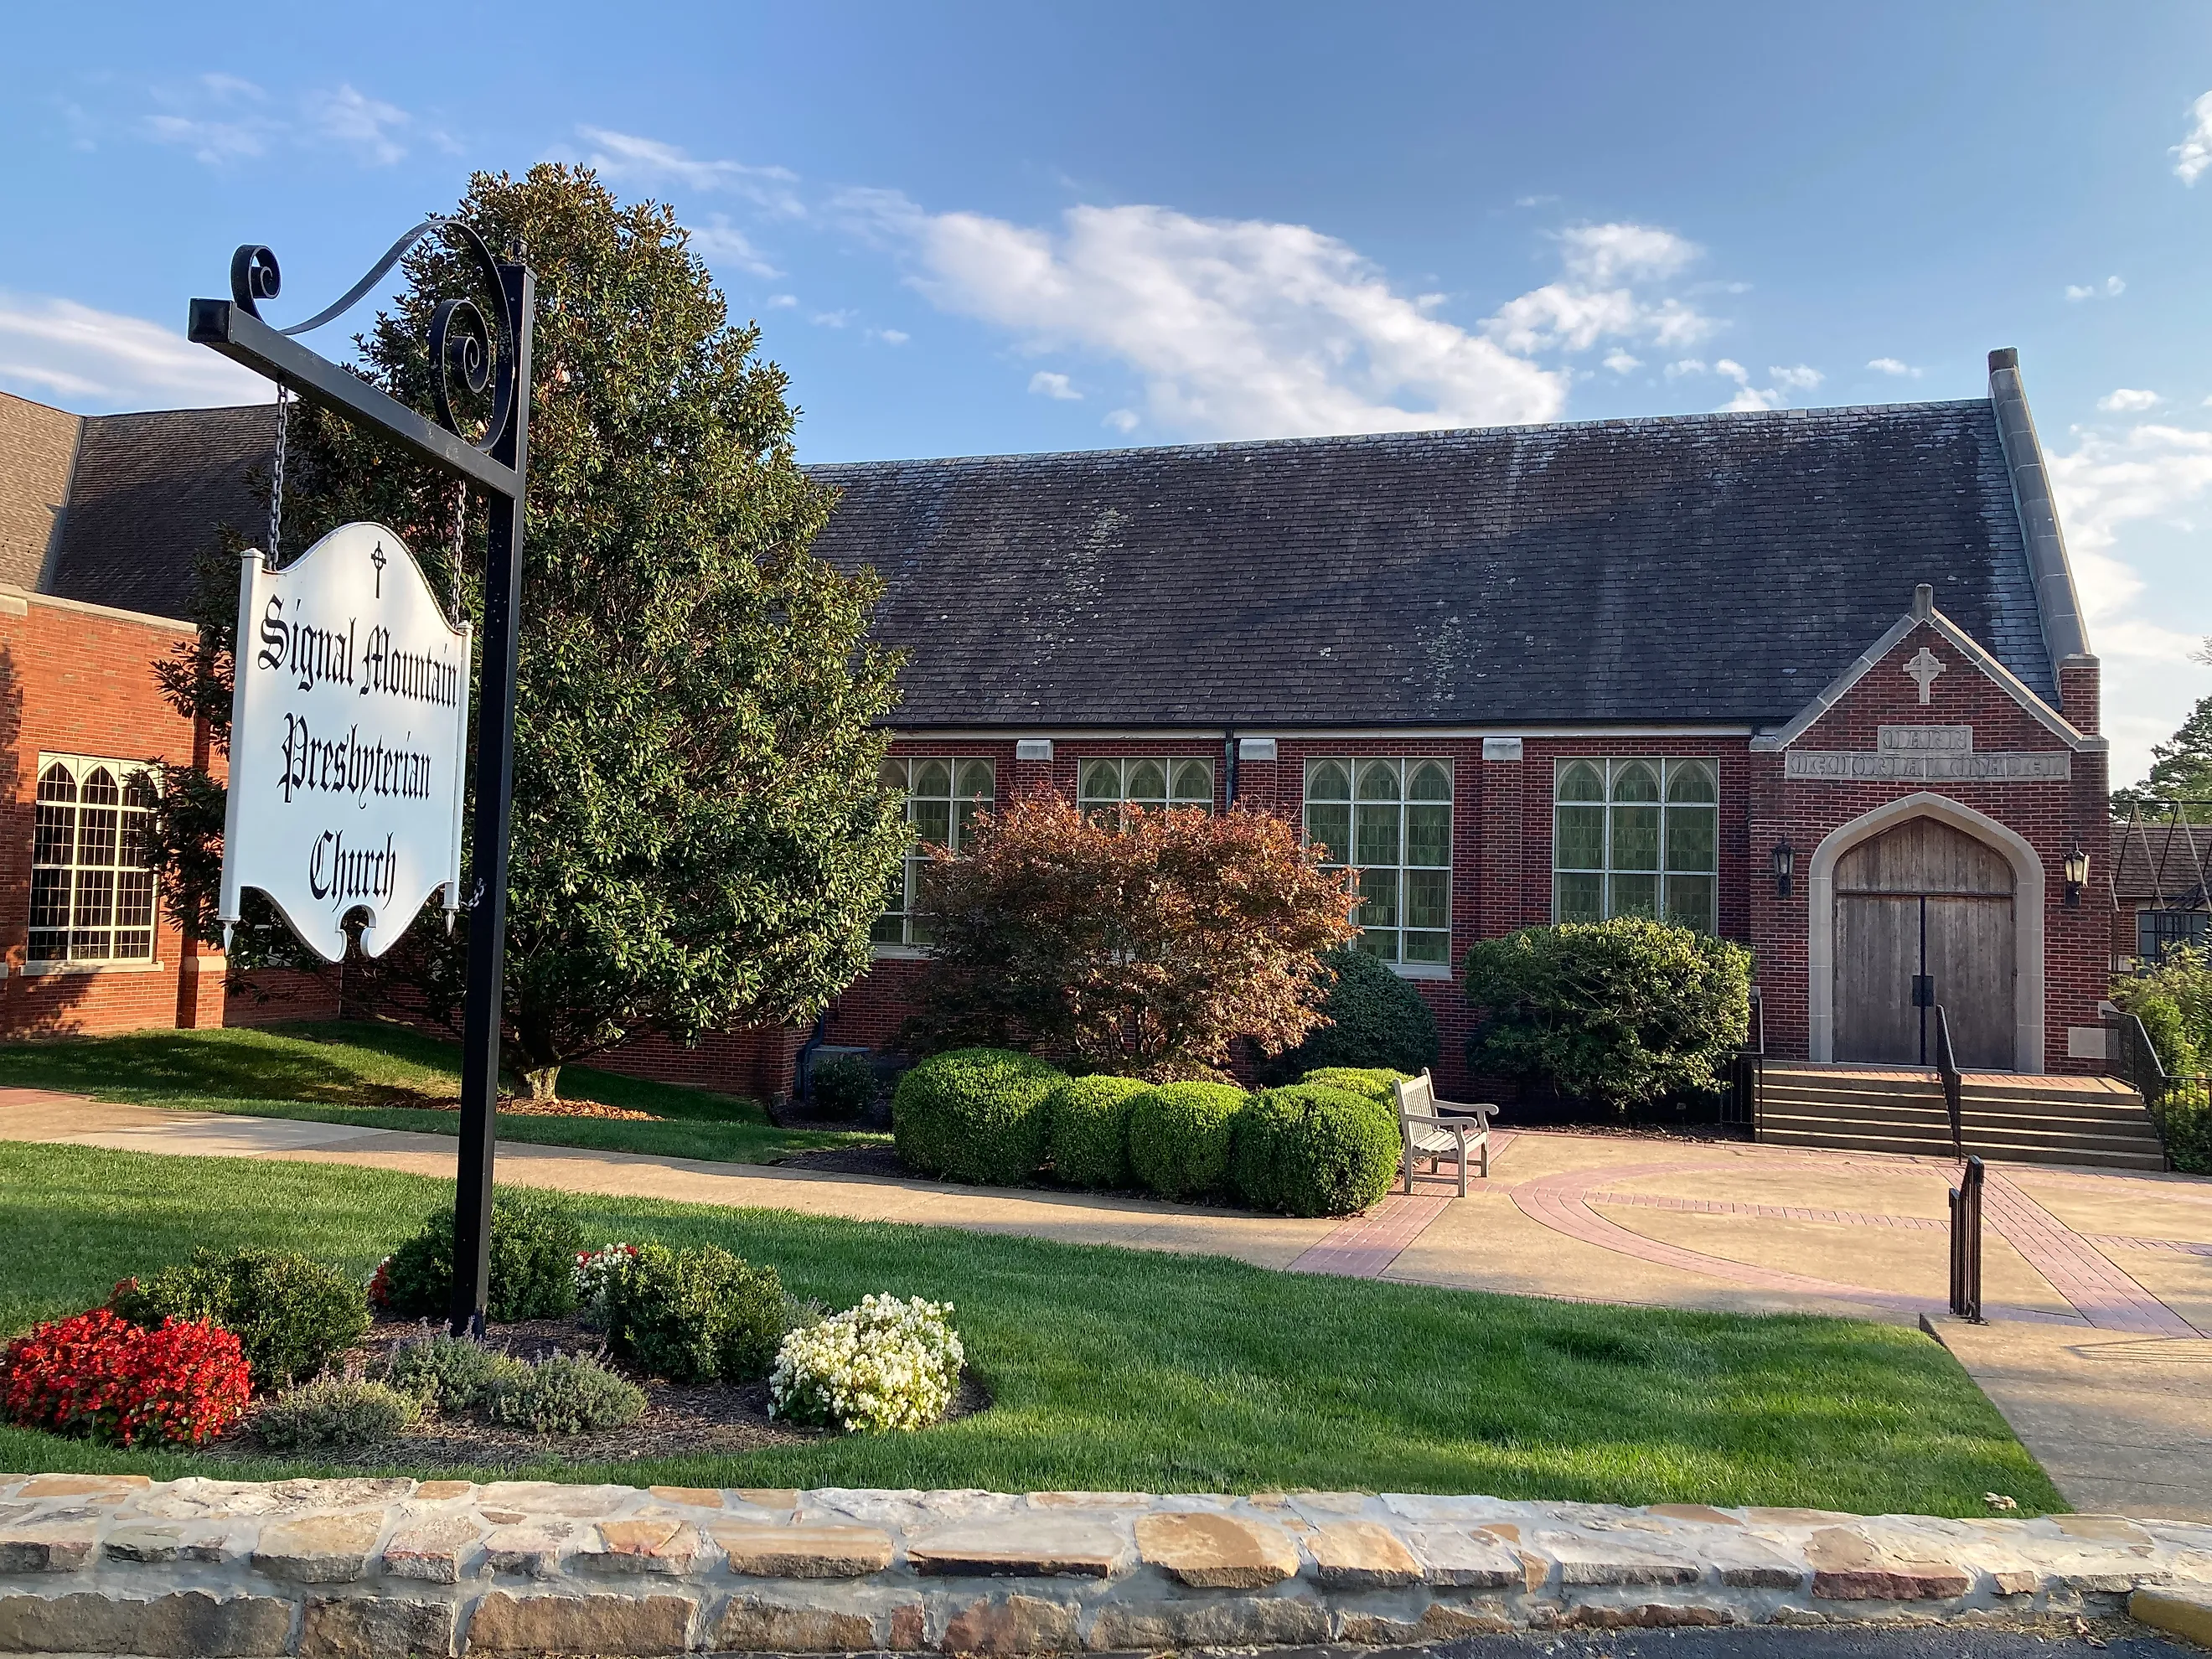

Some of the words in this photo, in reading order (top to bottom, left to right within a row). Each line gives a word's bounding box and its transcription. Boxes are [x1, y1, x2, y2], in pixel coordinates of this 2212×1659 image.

[258, 593, 356, 692] Signal
[359, 623, 457, 708] Mountain
[276, 712, 432, 809] Presbyterian
[1791, 755, 1940, 777] MEMORIAL
[1951, 755, 2065, 777] CHAPEL
[309, 829, 397, 912] Church
